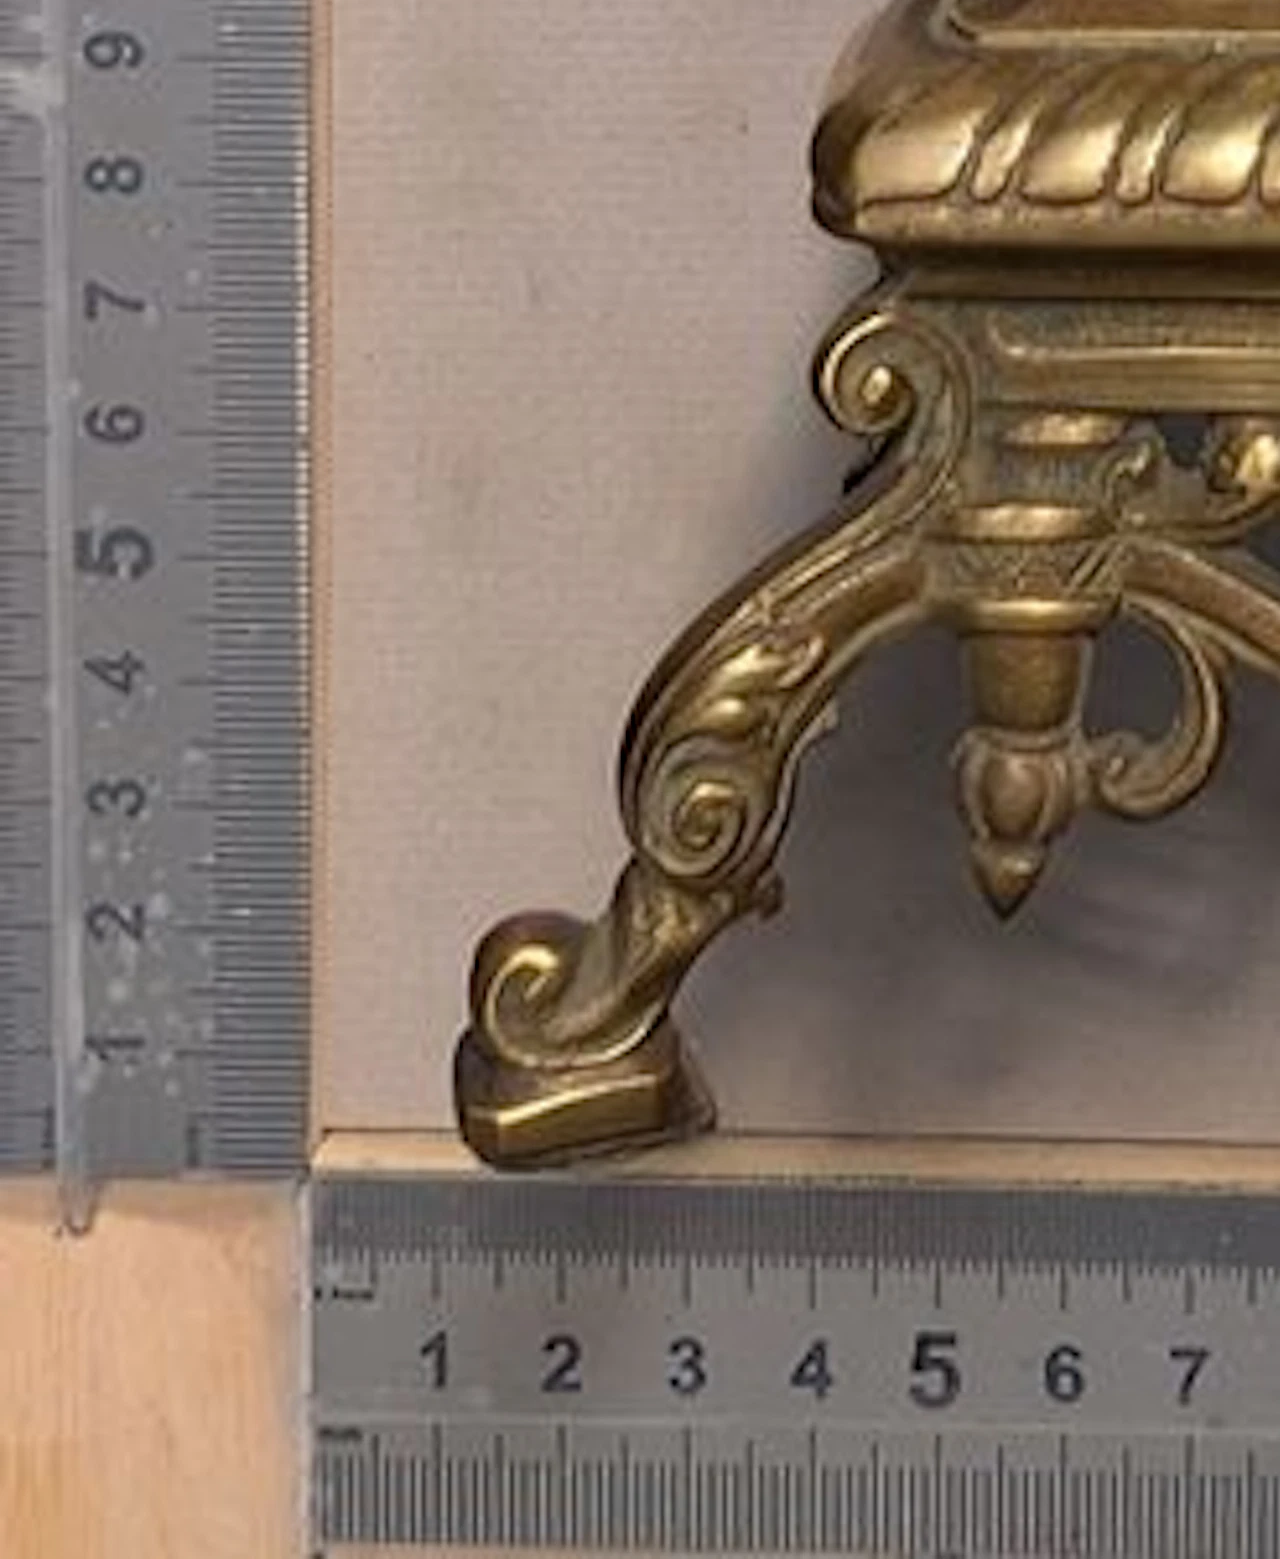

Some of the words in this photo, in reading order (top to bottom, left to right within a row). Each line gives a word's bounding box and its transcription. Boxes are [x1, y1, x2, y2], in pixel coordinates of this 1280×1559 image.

[83, 32, 144, 70] 9
[84, 158, 143, 195] 8
[84, 282, 144, 320] 7
[84, 406, 144, 444] 6
[75, 528, 153, 580] 5
[84, 651, 144, 696] 4
[86, 780, 146, 818] 3
[85, 903, 145, 942] 2
[84, 1035, 146, 1062] 1
[420, 1331, 447, 1389] 1
[541, 1334, 581, 1393] 2
[669, 1337, 706, 1396] 3
[790, 1340, 833, 1399] 4
[909, 1332, 960, 1408] 5
[1045, 1345, 1085, 1403] 6
[1170, 1348, 1211, 1405] 7
